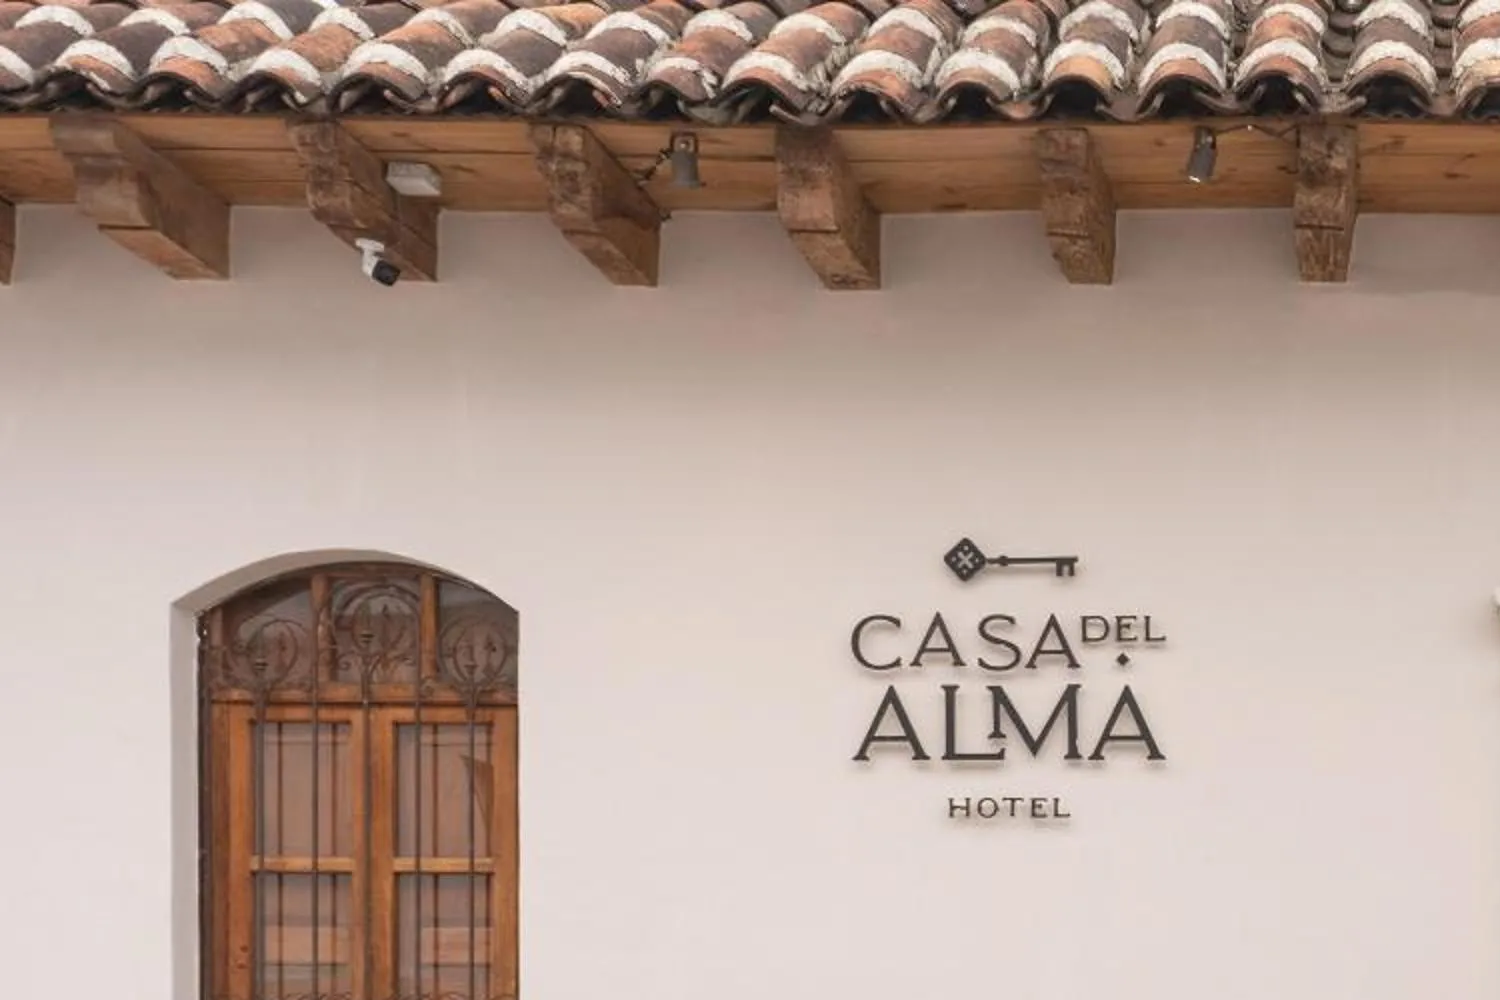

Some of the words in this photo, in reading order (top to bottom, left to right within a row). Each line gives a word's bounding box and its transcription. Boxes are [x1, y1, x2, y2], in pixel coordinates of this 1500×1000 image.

[850, 611, 1081, 671] CASA
[1080, 615, 1167, 643] DEL
[851, 683, 1167, 761] ALMA
[947, 797, 1071, 819] HOTEL
